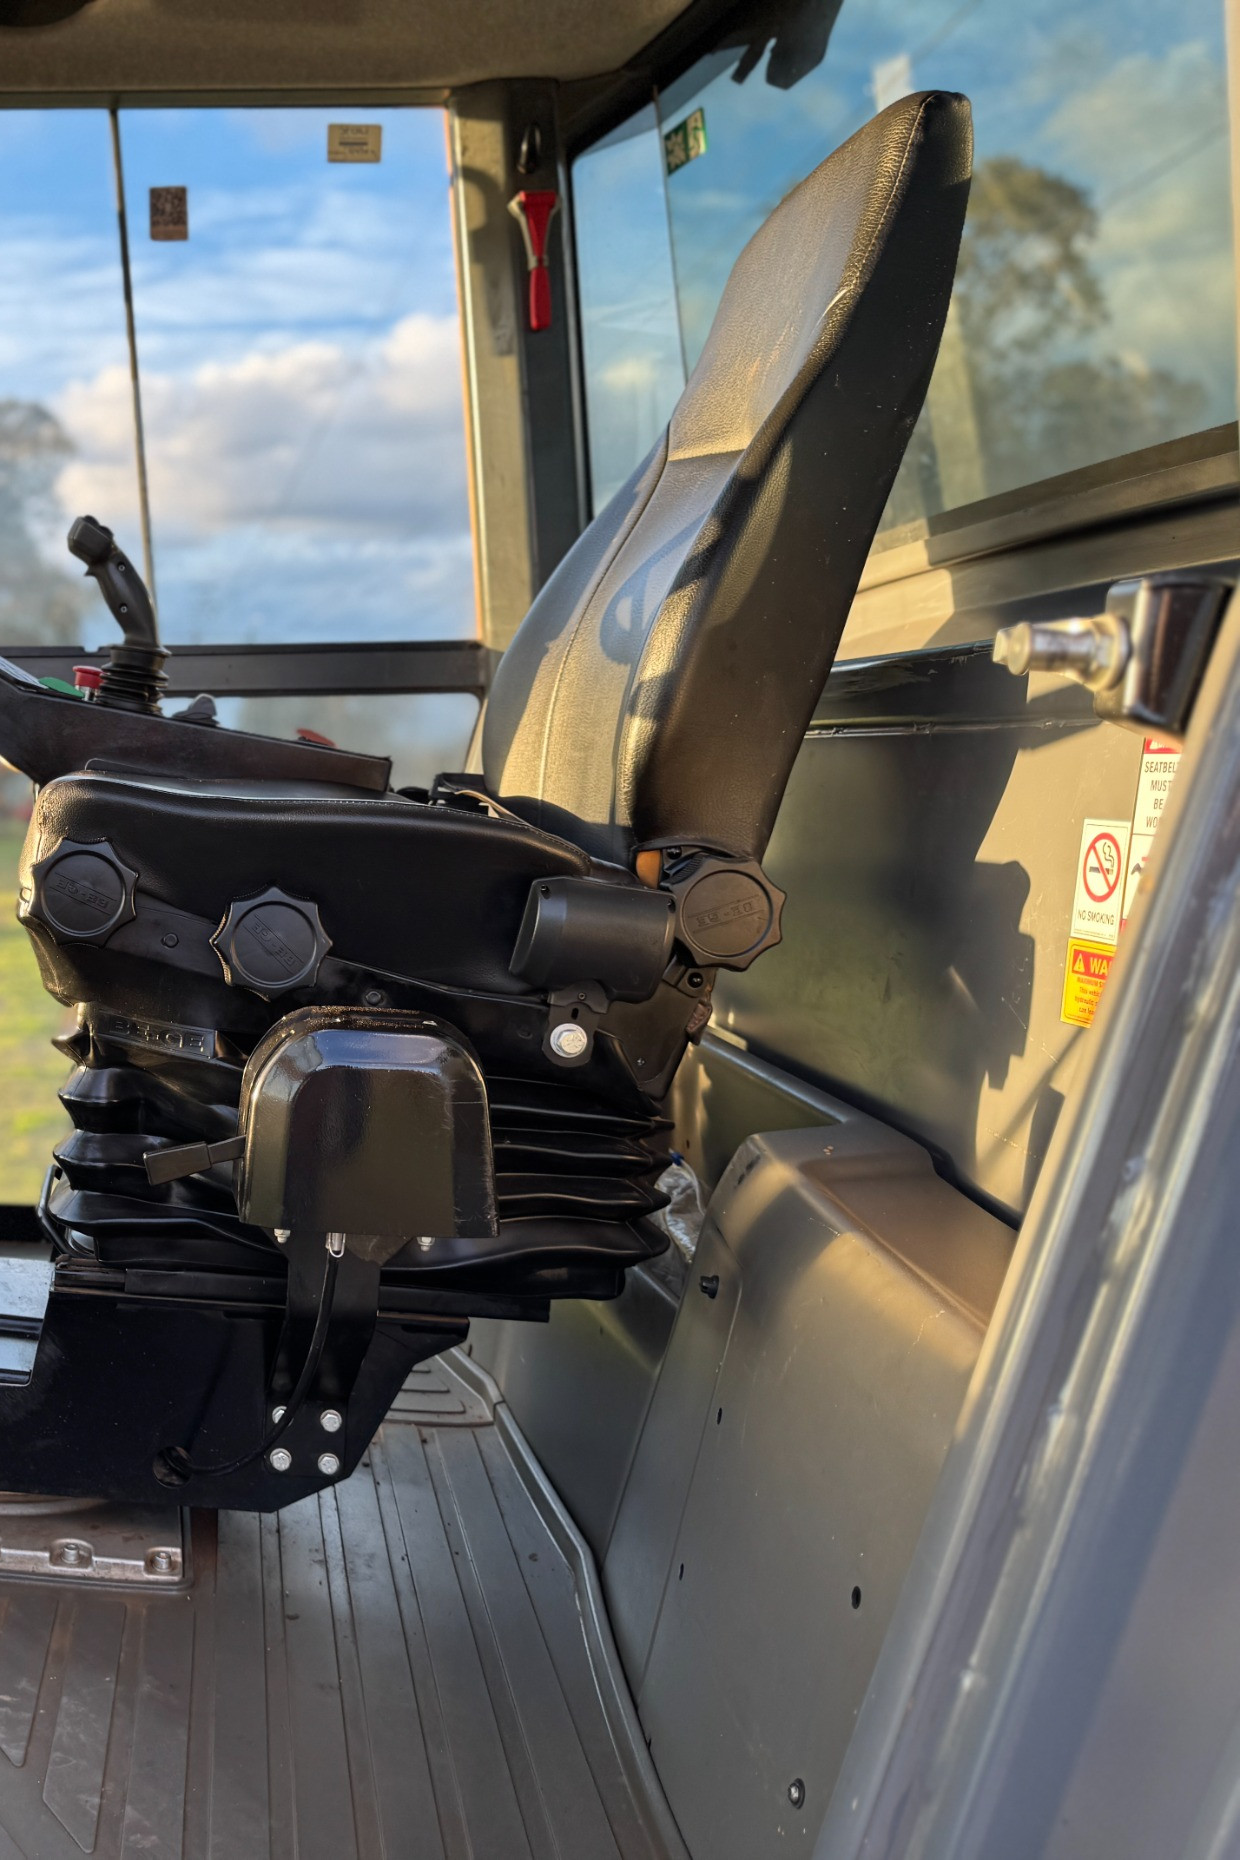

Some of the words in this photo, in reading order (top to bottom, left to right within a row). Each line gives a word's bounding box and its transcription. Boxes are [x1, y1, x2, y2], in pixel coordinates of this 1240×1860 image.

[1153, 798, 1164, 809] BE
[1146, 816, 1159, 828] WO
[1078, 909, 1087, 920] NO
[1087, 910, 1115, 925] SMOKING
